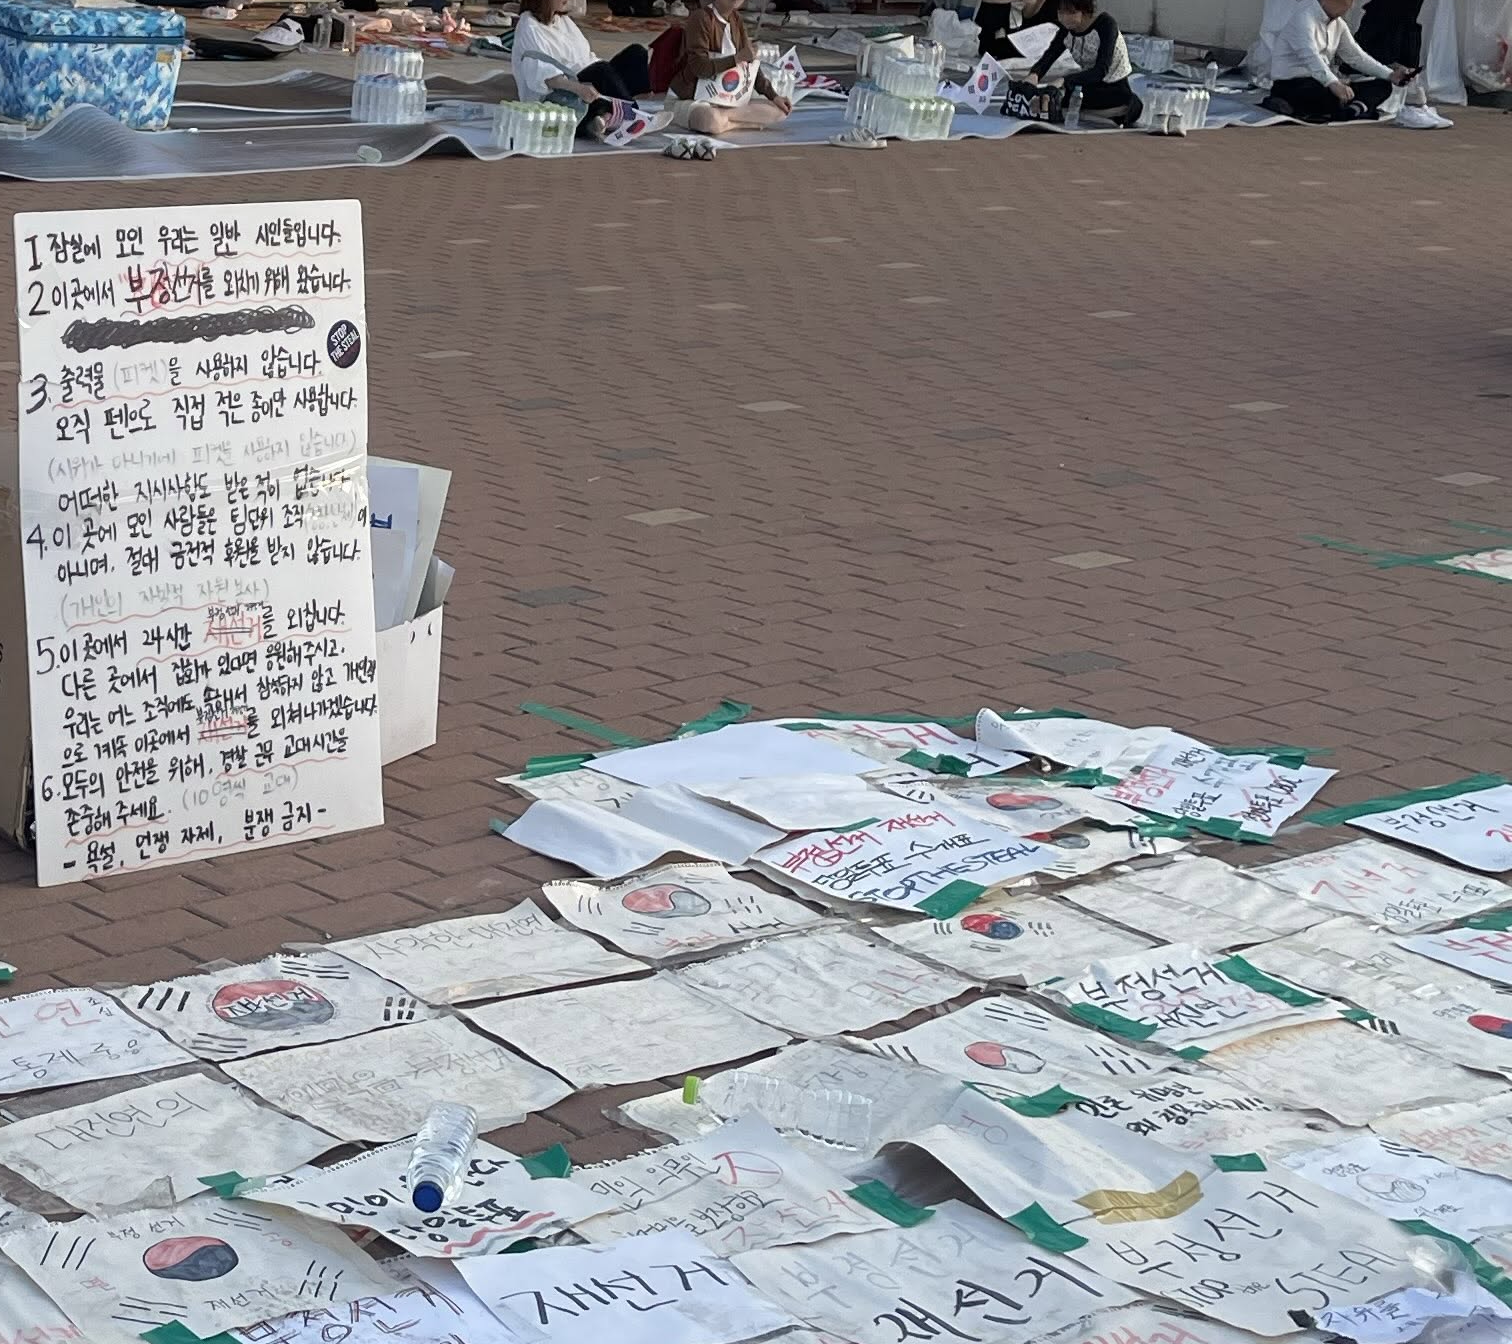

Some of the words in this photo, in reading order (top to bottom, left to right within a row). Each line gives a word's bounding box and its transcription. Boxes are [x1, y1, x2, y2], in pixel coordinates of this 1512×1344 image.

[47, 232, 101, 264] 잠실에
[116, 226, 144, 258] 모인
[158, 226, 199, 255] 우리는
[210, 220, 240, 256] 일반
[256, 218, 341, 247] 시민들입니다.
[28, 281, 50, 316] 2
[52, 277, 115, 309] 이곳에서
[224, 268, 259, 298] 외치기
[264, 265, 289, 296] 위해
[297, 264, 351, 294] 왔습니다.
[330, 324, 347, 347] STOP
[342, 330, 360, 352] STEAL
[26, 373, 52, 414] 3.
[60, 362, 105, 403] 출력물
[195, 354, 248, 380] 사용하지
[261, 344, 322, 379] 않습니다.
[56, 409, 91, 444] 오직
[104, 400, 156, 440] 펜으로
[173, 395, 205, 430] 직접
[216, 391, 244, 424] 적은
[251, 387, 286, 423] 종이만
[293, 386, 357, 419] 사용합니다.
[59, 479, 119, 517] 어떠한
[134, 472, 211, 505] 지시사항도
[225, 471, 249, 504] 받은
[255, 471, 280, 506] 적이
[26, 523, 48, 560] 4.
[53, 523, 71, 549] 이
[82, 517, 116, 554] 곳에
[127, 508, 152, 538] 모인
[164, 504, 217, 537] 사람들은
[231, 504, 274, 535] 팀단위
[282, 504, 304, 529] 조직
[57, 553, 115, 586] 아니며,
[125, 545, 159, 576] 절대
[171, 538, 215, 570] 금전적
[224, 536, 261, 568] 후원을
[267, 536, 295, 566] 받지
[307, 534, 361, 566] 않습니다.
[37, 637, 60, 674] 5.
[143, 622, 192, 654] 24시간
[288, 599, 345, 632] 외칩니다.
[62, 668, 97, 700] 다른
[107, 666, 157, 694] 곳에서
[172, 658, 212, 686] 집회가
[218, 650, 257, 676] 있다면
[63, 707, 103, 739] 우리는
[108, 704, 136, 726] 어느
[142, 693, 196, 722] 조직에도
[257, 673, 303, 700] 참석하지
[312, 664, 337, 692] 않고
[343, 656, 376, 684] 개인적
[61, 743, 84, 768] 으로
[94, 735, 128, 758] 계속
[135, 725, 189, 753] 이곳에서
[270, 694, 378, 730] 외쳐나가겠습니다.
[41, 776, 61, 803] 6.
[62, 768, 105, 802] 모두의
[115, 758, 160, 789] 안전을
[168, 755, 214, 782] 위해,
[220, 745, 248, 774] 경찰
[253, 742, 275, 766] 근무
[284, 728, 349, 760] 교대시간을
[64, 804, 112, 837] 존중해
[116, 795, 171, 825] 주세요.
[87, 840, 124, 873] 욕설,
[135, 832, 170, 860] 언쟁
[181, 820, 223, 845] 자제,
[243, 809, 274, 837] 분쟁
[281, 801, 311, 827] 금지
[1383, 799, 1501, 834] 부정선거
[1079, 961, 1228, 1011] 부정선거
[1104, 1180, 1321, 1280] 부정선거
[499, 1259, 729, 1327] 재선거
[1171, 1281, 1230, 1309] STOP
